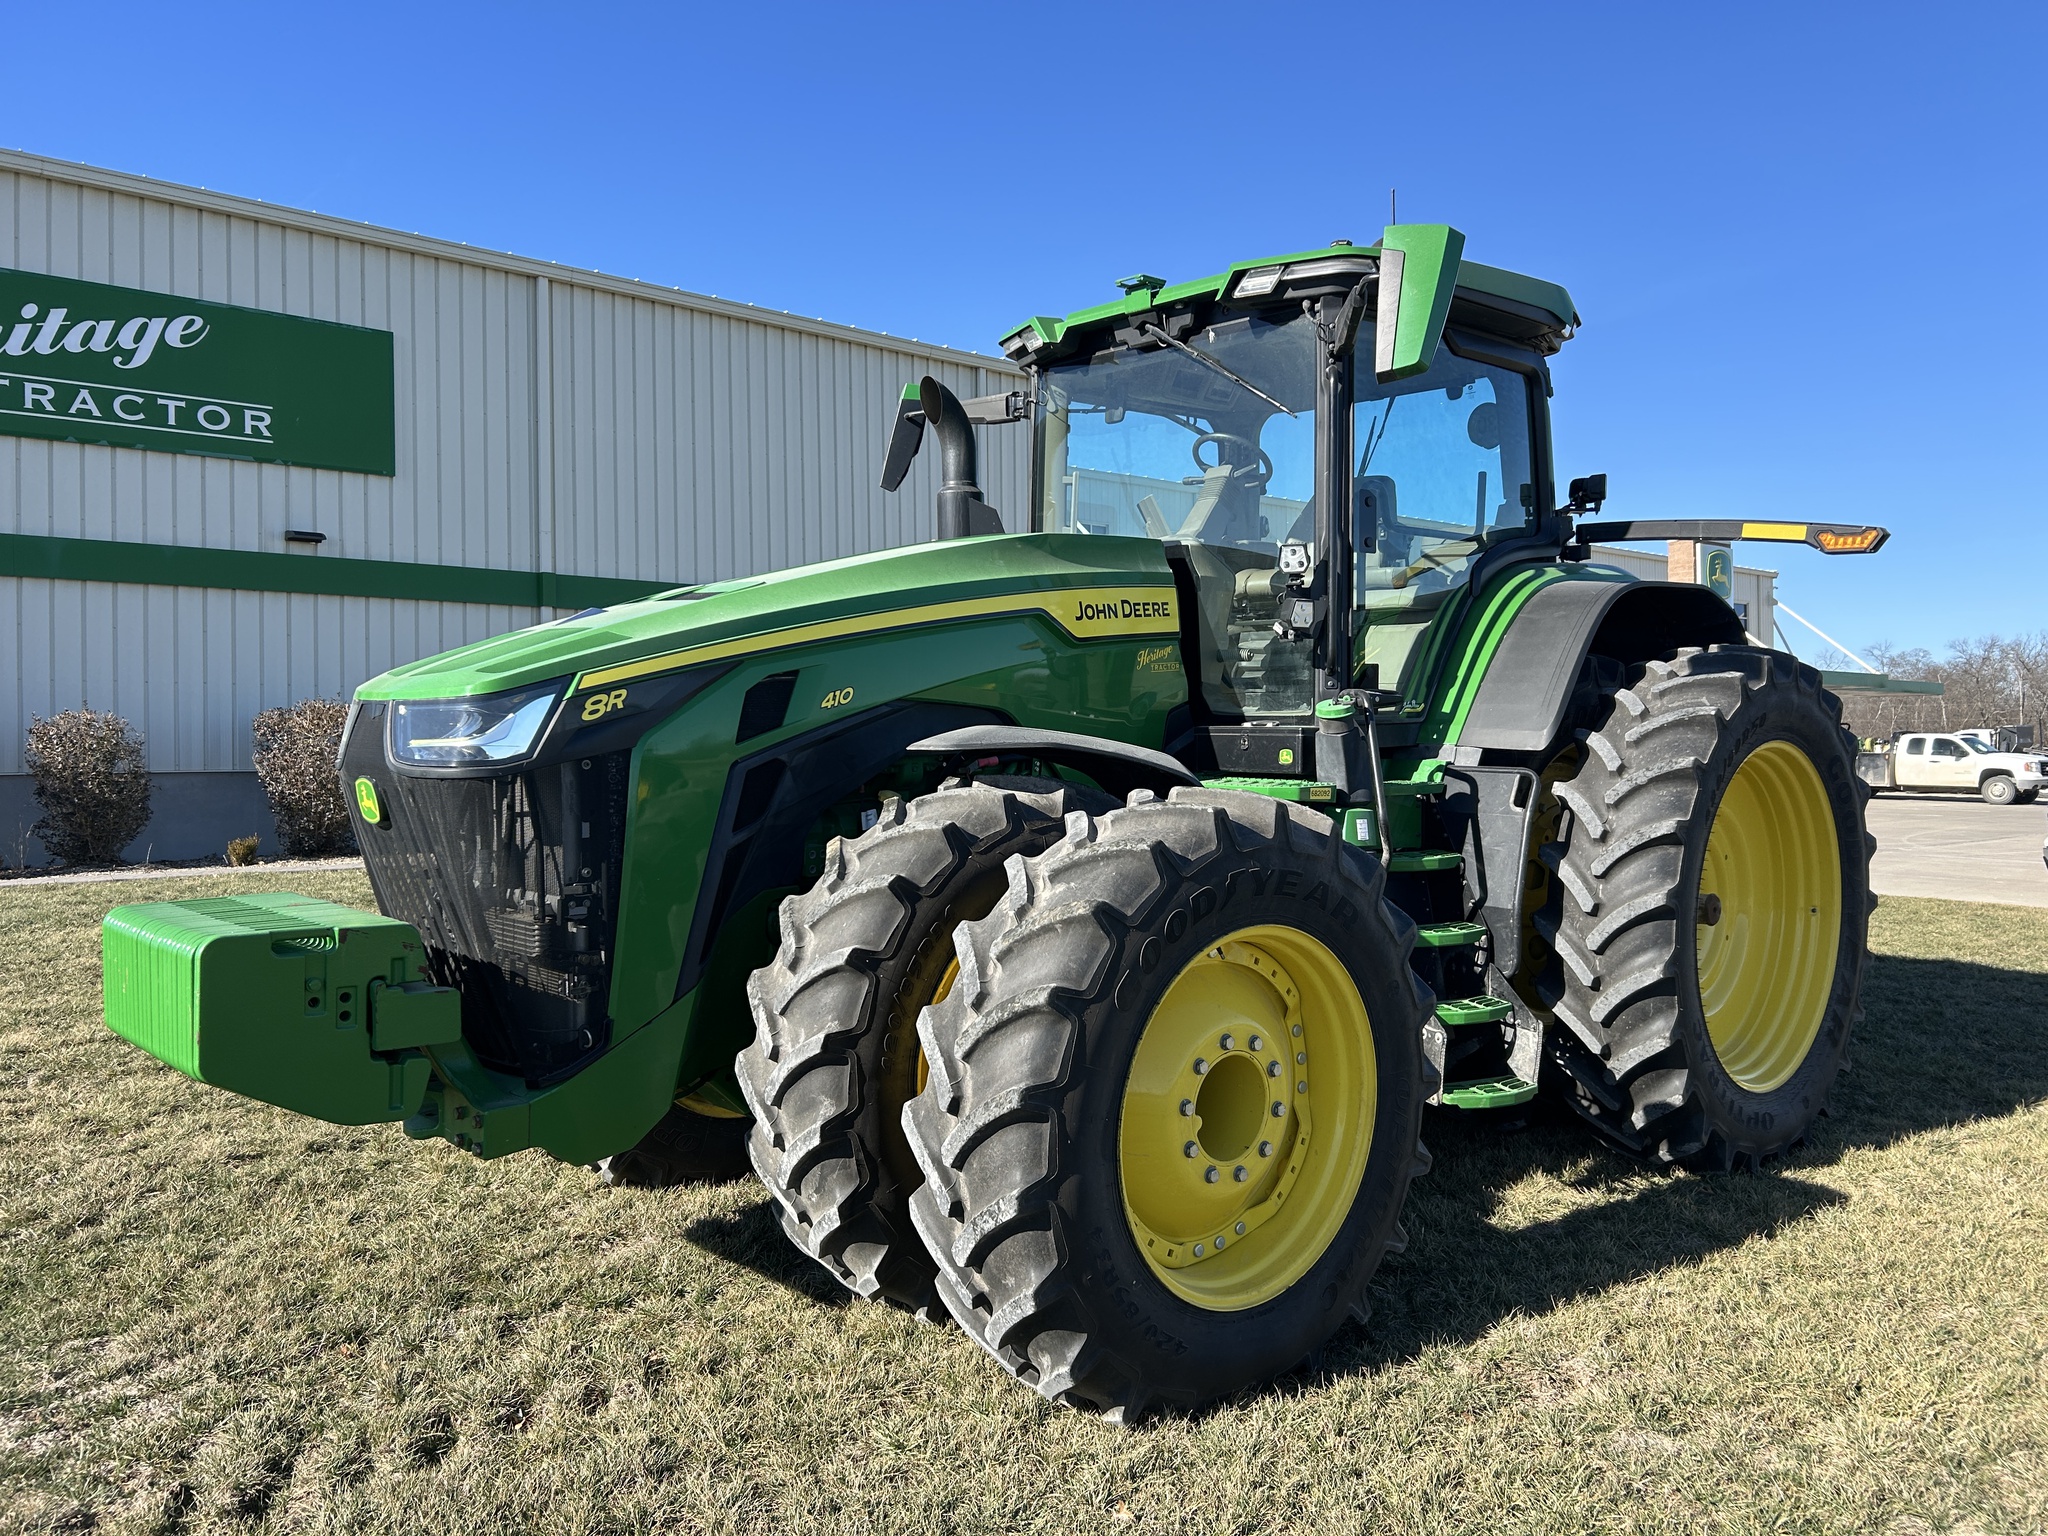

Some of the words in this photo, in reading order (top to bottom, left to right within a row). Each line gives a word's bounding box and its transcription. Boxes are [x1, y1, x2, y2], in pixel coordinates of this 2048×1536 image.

[0, 303, 210, 369] itage
[1075, 601, 1118, 621] JOHN
[1121, 599, 1171, 618] DEERE
[1136, 645, 1173, 670] Heritage
[1150, 663, 1180, 671] TRACTOR
[581, 688, 628, 721] 8R
[820, 687, 854, 709] 410
